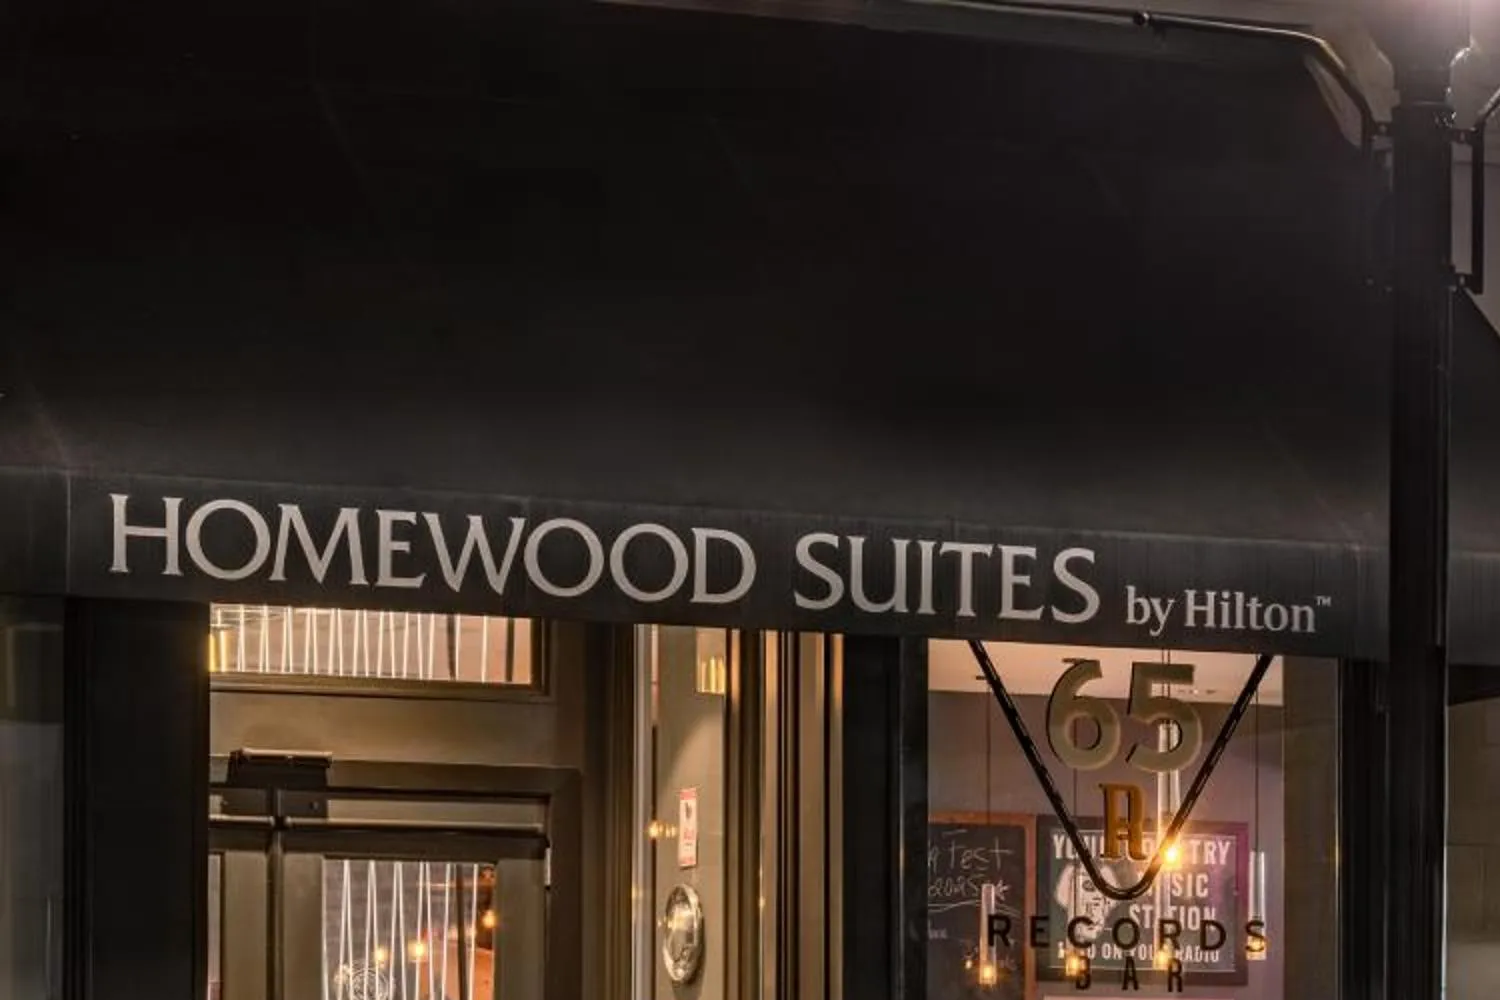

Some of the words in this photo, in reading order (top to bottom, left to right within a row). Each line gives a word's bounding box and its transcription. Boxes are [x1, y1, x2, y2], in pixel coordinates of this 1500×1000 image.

[109, 493, 758, 603] HOMEWOOD
[793, 532, 1100, 624] SUITES
[1125, 585, 1175, 637] by
[1046, 658, 1202, 772] 65
[1099, 782, 1150, 859] R
[1053, 834, 1114, 859] YOU
[1127, 837, 1231, 866] OTRY
[1138, 871, 1209, 898] SIC
[987, 915, 1267, 953] RECORDS
[1129, 904, 1217, 932] STTION
